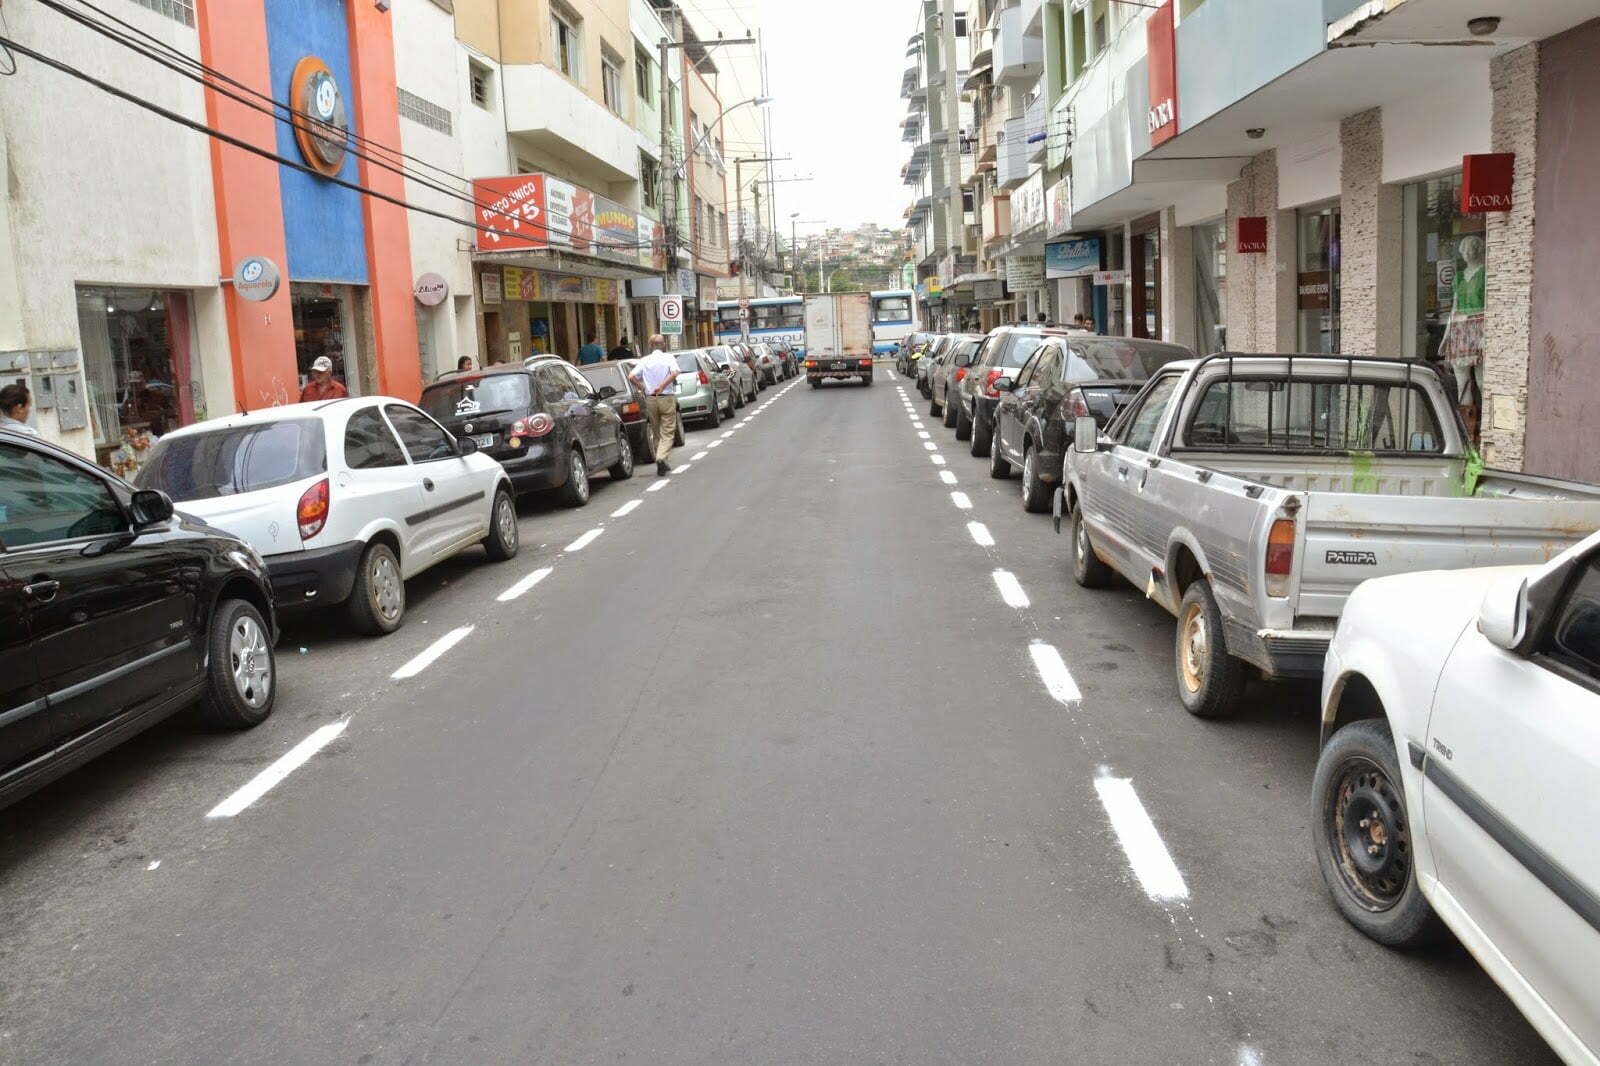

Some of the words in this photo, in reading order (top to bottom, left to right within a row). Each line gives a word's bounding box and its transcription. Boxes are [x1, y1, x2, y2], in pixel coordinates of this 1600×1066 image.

[482, 197, 509, 221] PREÇO
[508, 182, 536, 204] ÚNICO
[1469, 193, 1511, 207] ÉVORA
[596, 211, 636, 229] MUNDO
[667, 304, 675, 316] E
[1327, 551, 1376, 563] PAMPA
